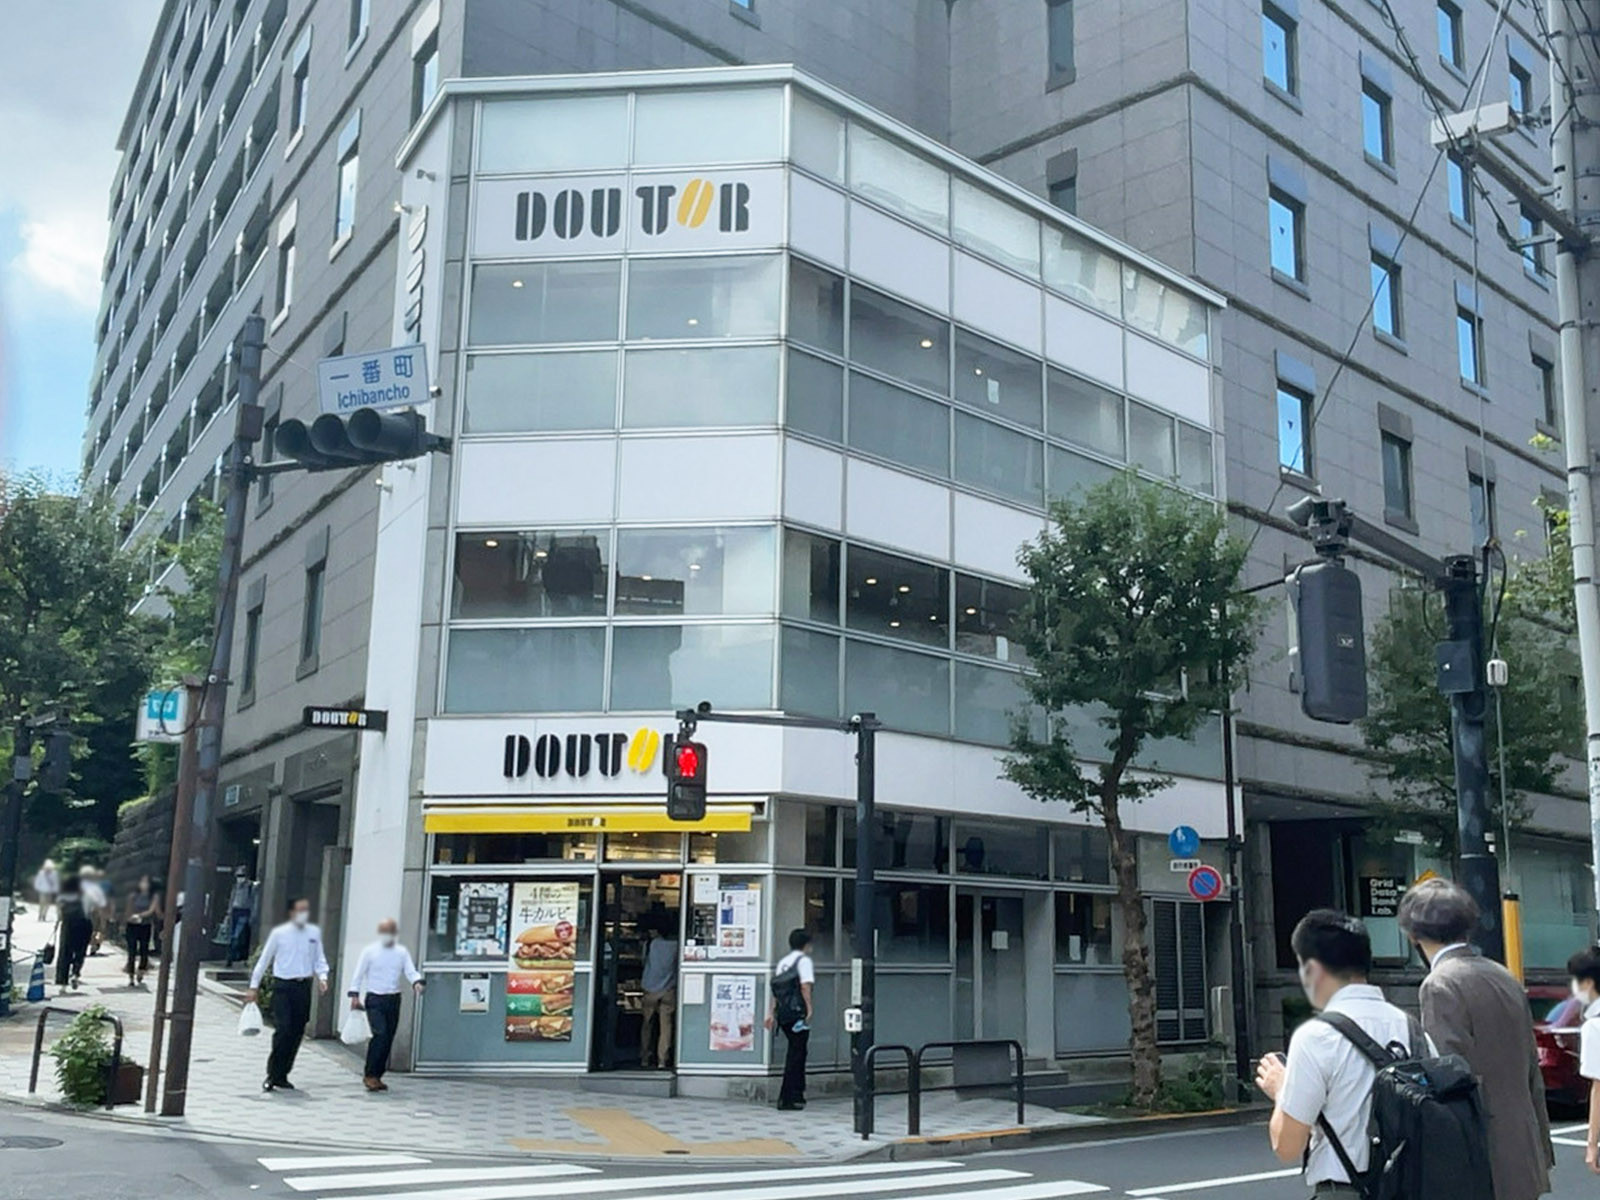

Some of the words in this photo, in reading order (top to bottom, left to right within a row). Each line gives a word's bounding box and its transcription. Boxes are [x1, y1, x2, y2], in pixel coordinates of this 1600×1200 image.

[515, 178, 750, 241] DOUTOR
[329, 354, 414, 385] 一番町
[338, 383, 410, 409] Ichibancho
[312, 710, 367, 726] DOUTOR
[1369, 879, 1394, 888] Grid
[519, 906, 571, 923] 牛カルビ
[716, 983, 752, 1001] 誕生
